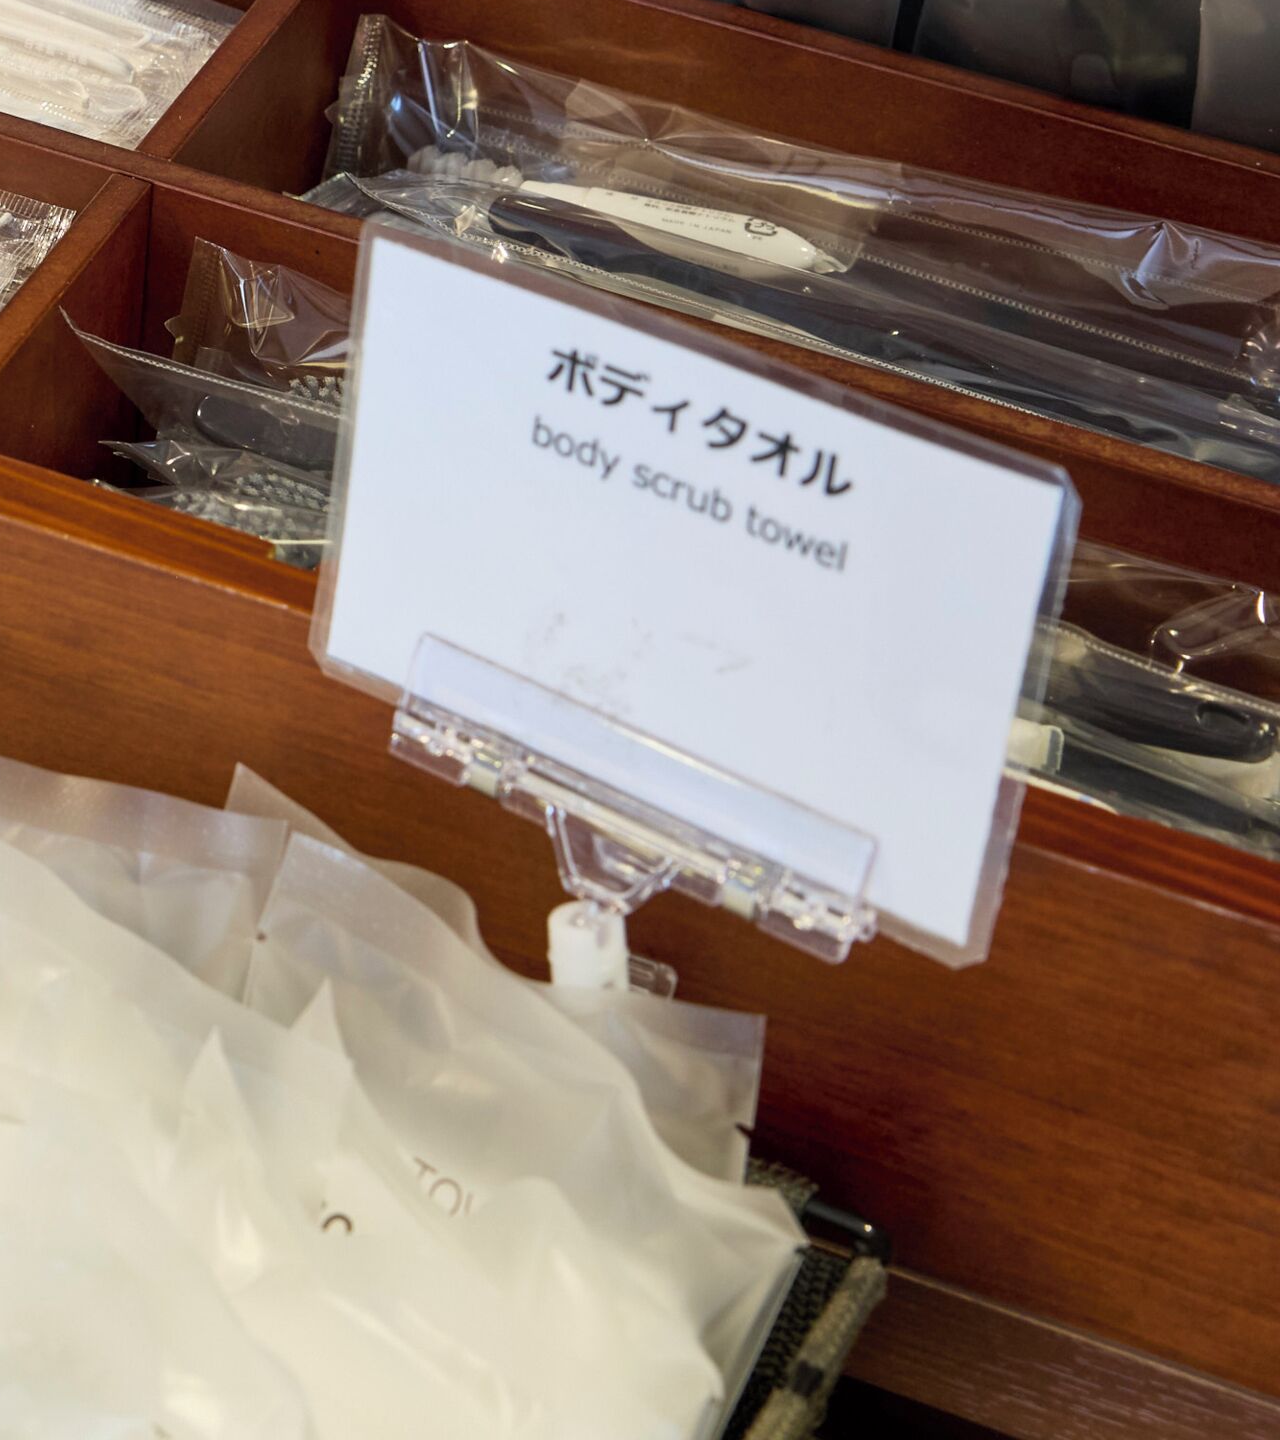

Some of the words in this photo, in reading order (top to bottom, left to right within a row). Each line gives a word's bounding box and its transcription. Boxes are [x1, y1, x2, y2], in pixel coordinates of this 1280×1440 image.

[530, 414, 622, 483] body
[631, 461, 735, 526] scrub
[743, 502, 851, 574] towel
[545, 344, 857, 501] ボディタオル
